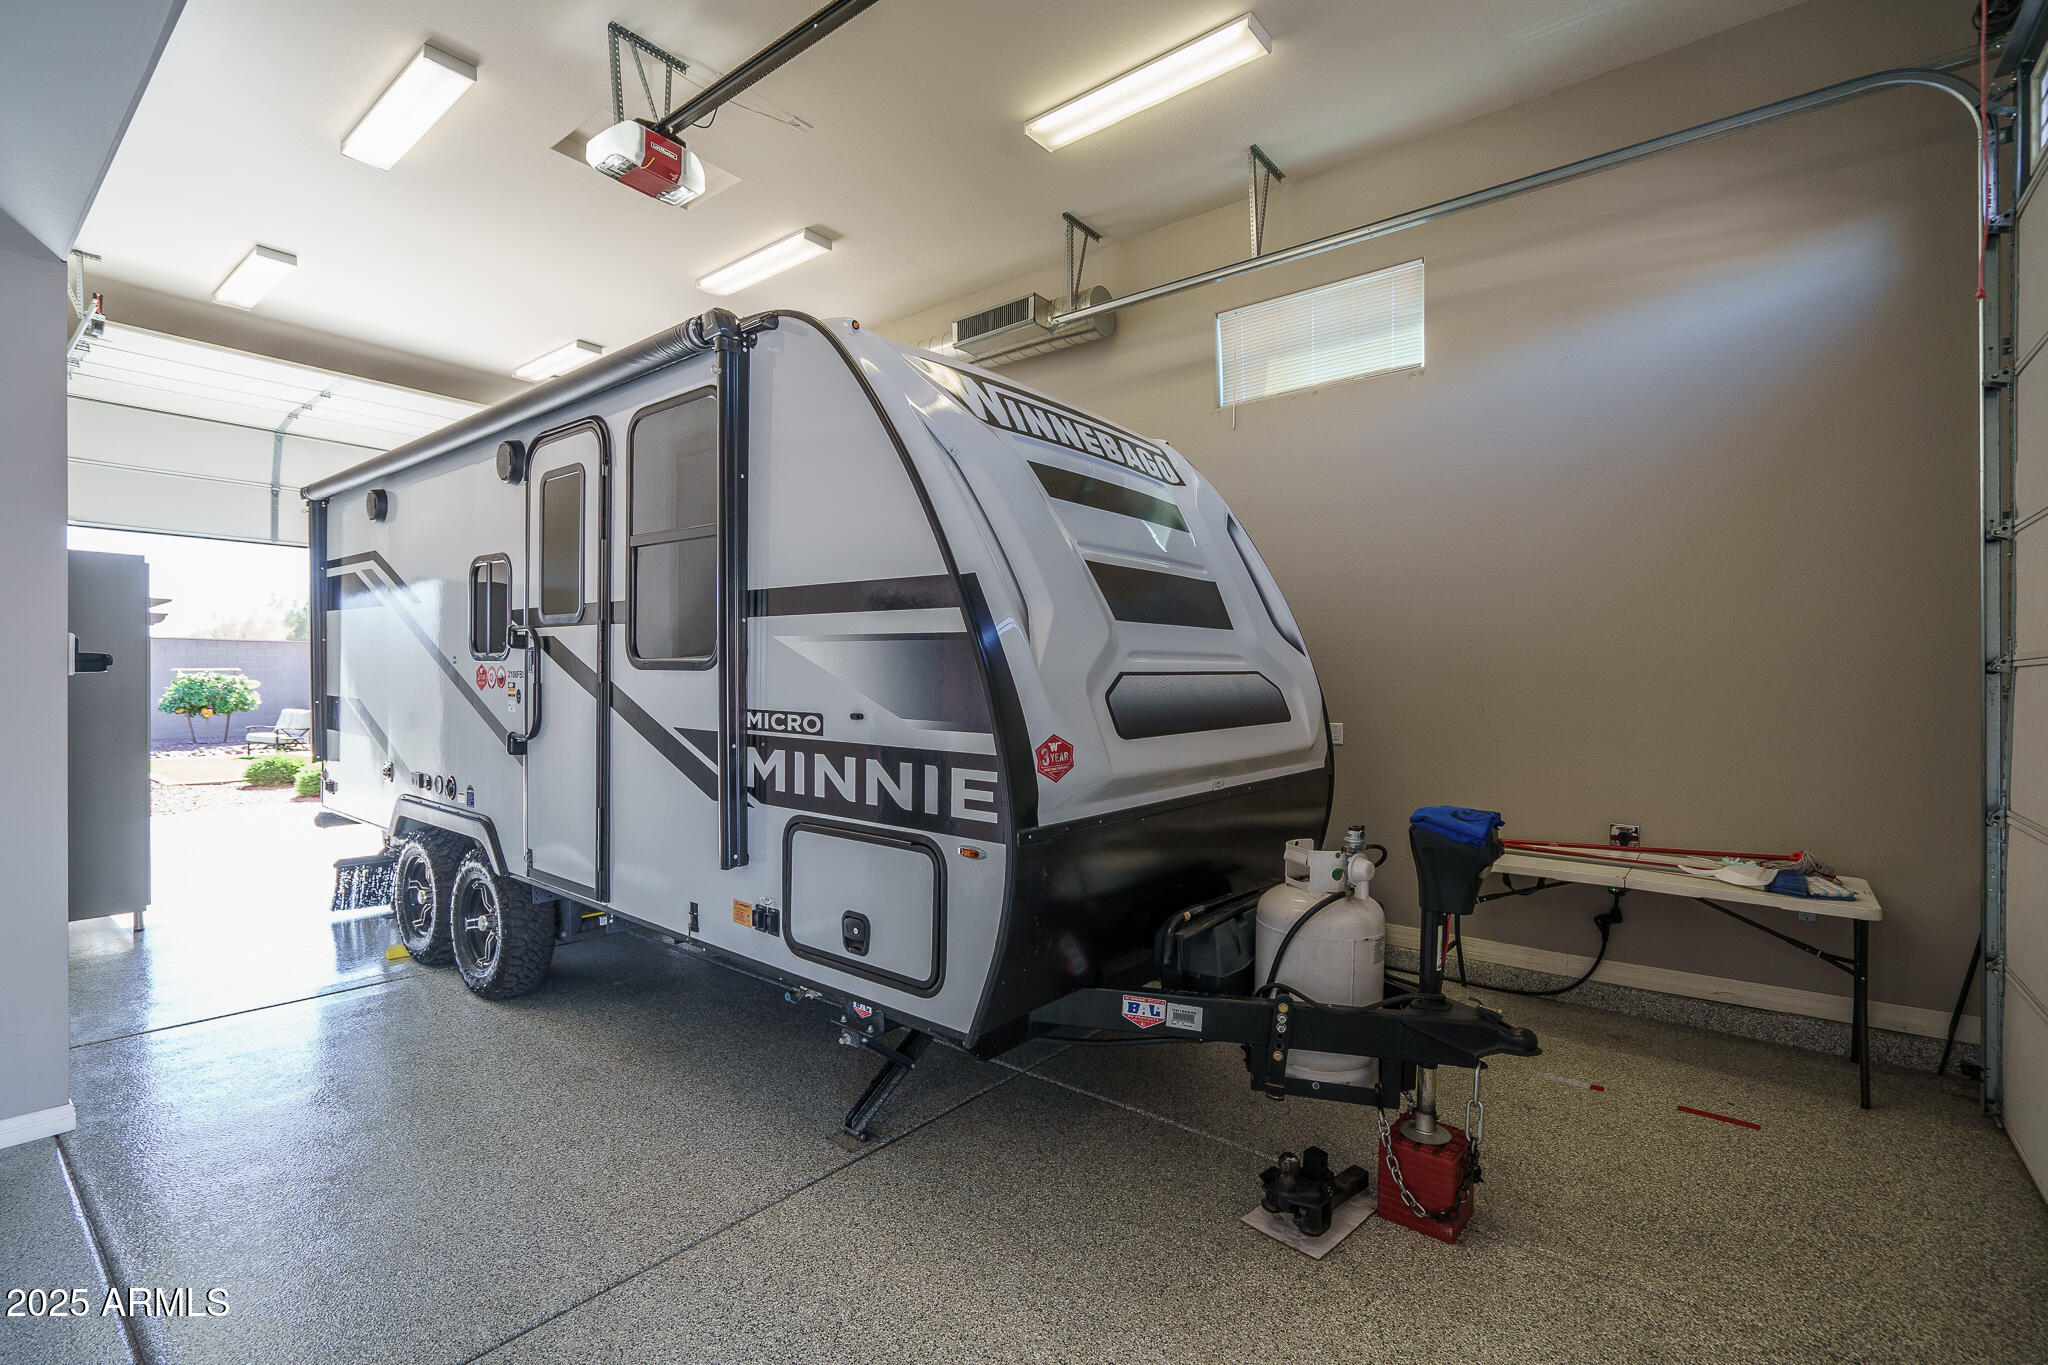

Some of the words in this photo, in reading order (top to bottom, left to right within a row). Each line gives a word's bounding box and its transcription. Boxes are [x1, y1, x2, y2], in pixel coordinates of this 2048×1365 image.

[959, 374, 1180, 484] WINNEBAGO
[747, 711, 822, 733] MICRO
[1041, 748, 1050, 766] 3
[1051, 751, 1069, 762] YEAR
[747, 746, 998, 824] MINNIE
